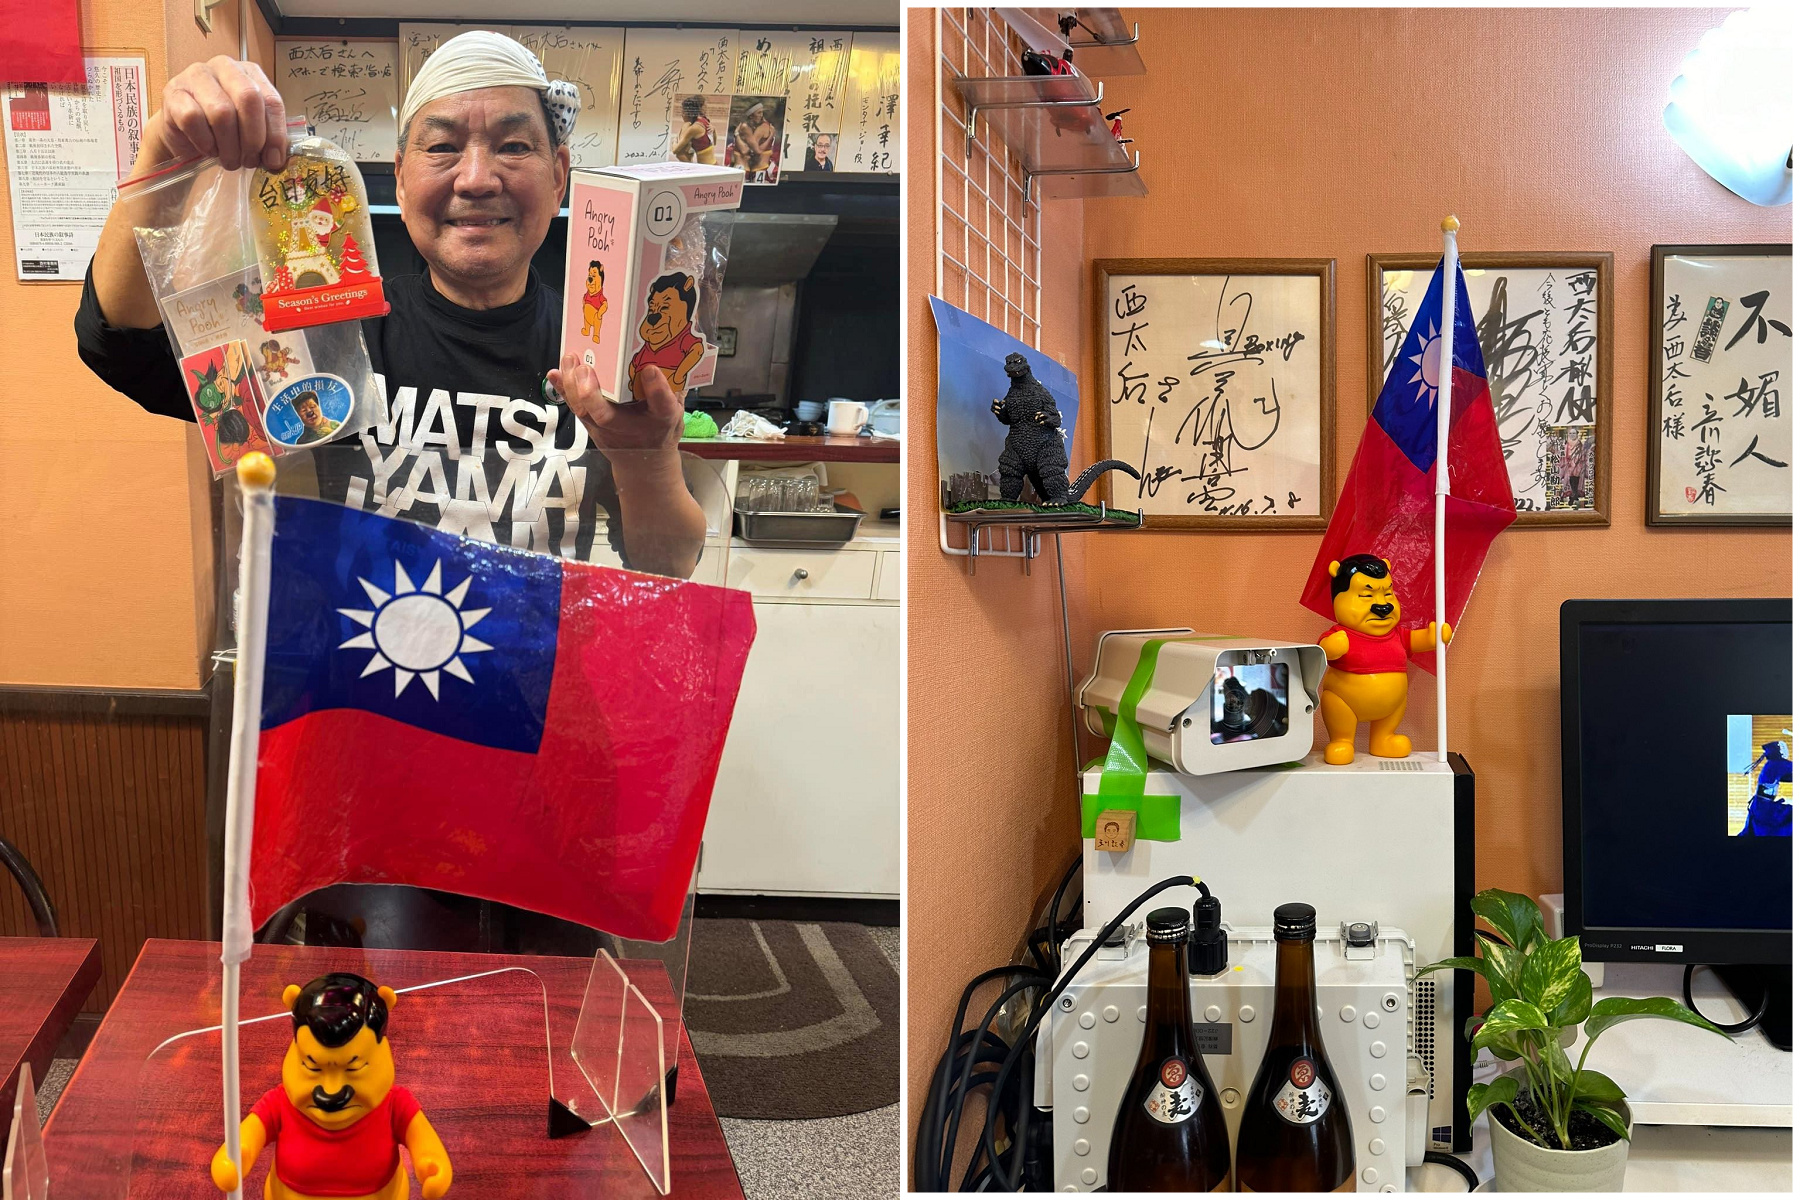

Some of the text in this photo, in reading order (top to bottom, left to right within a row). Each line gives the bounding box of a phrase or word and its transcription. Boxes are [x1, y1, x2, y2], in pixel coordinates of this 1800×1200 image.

[114, 67, 125, 132] 祖国を形づくるもの
[259, 165, 351, 209] 台日友好
[694, 185, 733, 205] Angry Pooh
[585, 200, 615, 236] Angry
[654, 205, 673, 222] 01
[588, 227, 611, 252] Pooh
[176, 298, 219, 320] Angry
[321, 289, 368, 304] Greetings
[585, 354, 593, 365] 01
[1723, 290, 1792, 470] 不媚人
[359, 373, 588, 465] MATSU
